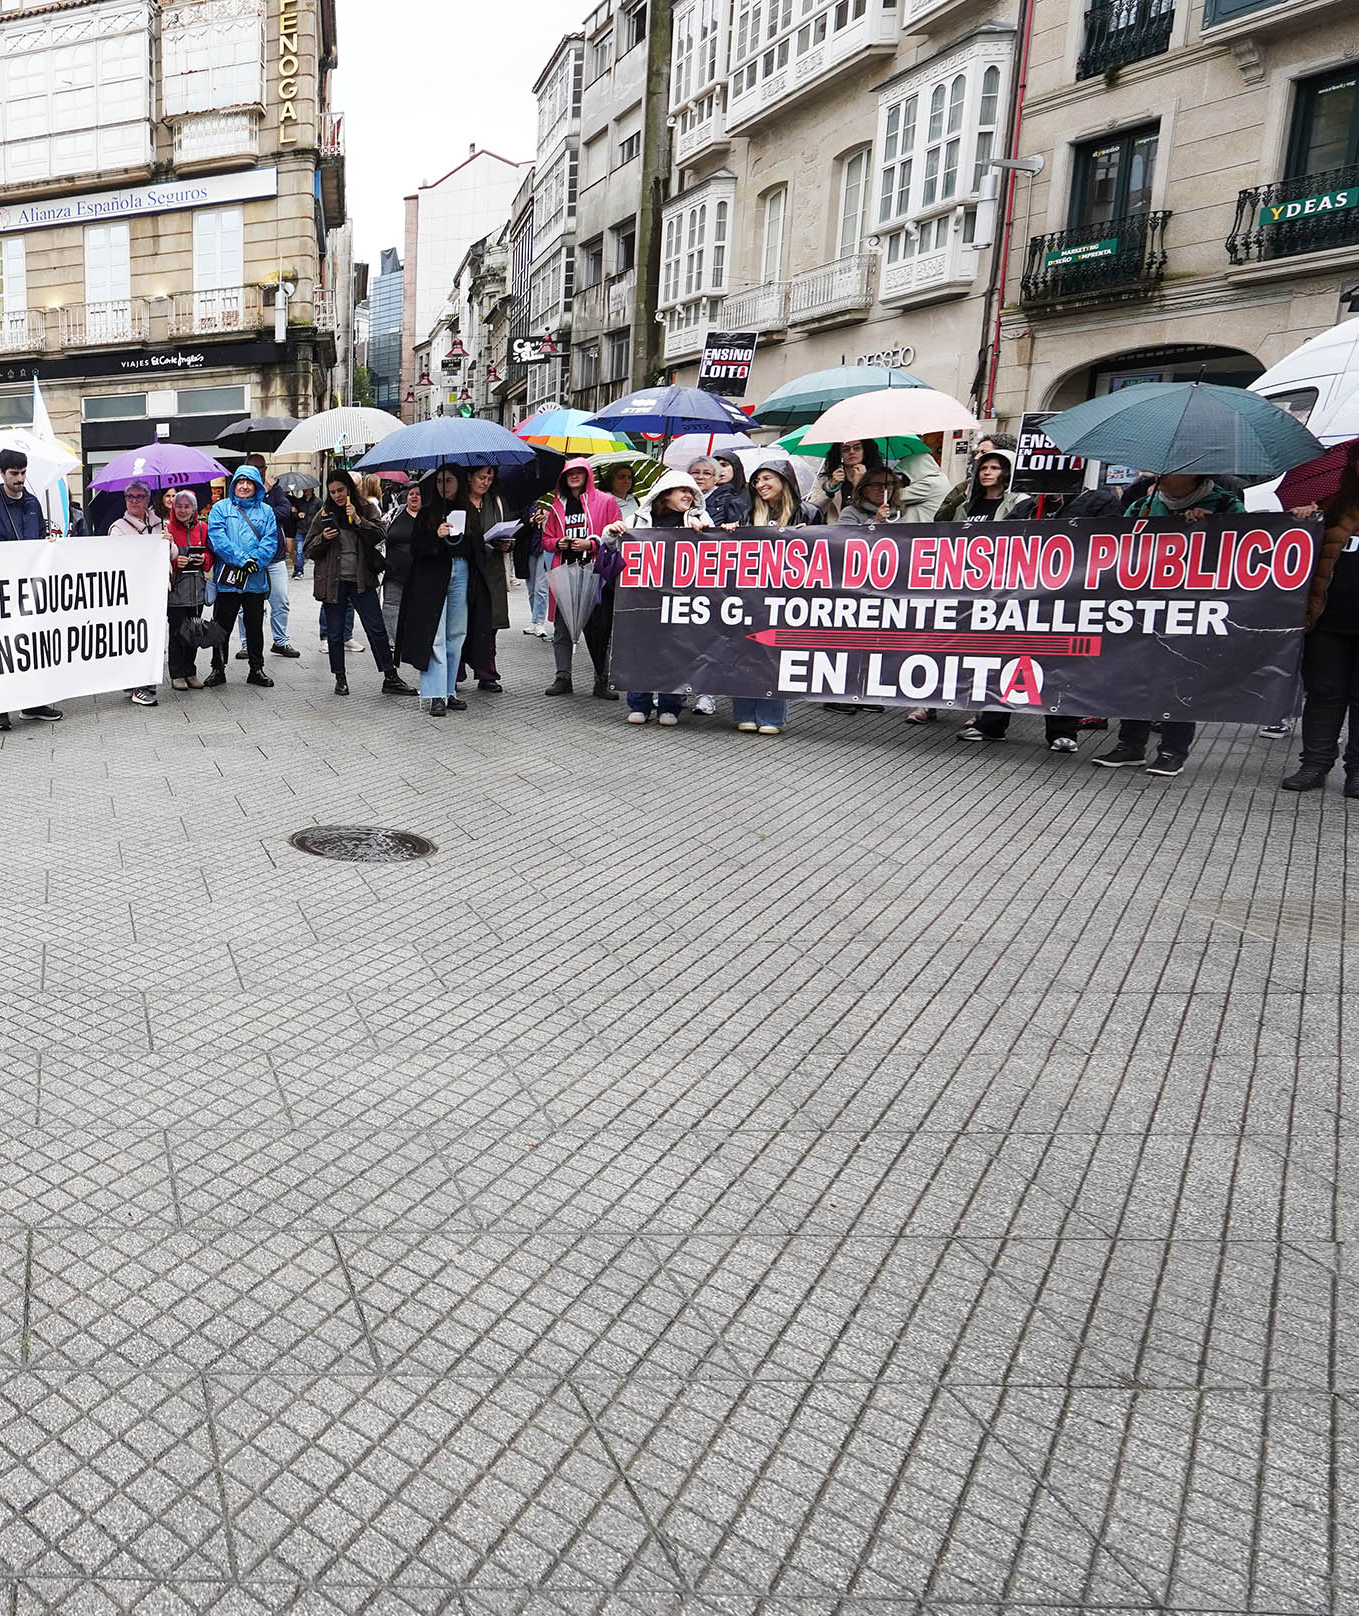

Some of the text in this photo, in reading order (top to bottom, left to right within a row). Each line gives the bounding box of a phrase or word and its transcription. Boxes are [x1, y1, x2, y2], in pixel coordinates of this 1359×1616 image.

[19, 187, 208, 223] Alianza Española Seguros
[1270, 192, 1348, 221] YDEAS
[120, 359, 149, 369] VIAJES
[703, 348, 753, 361] ENSINO
[700, 365, 749, 379] LOITA
[1018, 448, 1033, 456] EN
[1019, 433, 1056, 449] ENS
[1016, 454, 1085, 471] LOITA
[619, 520, 1314, 592] EN DEFENSA DO ENSINO PÚBLICO
[19, 569, 129, 617] EDUCATIVA
[660, 596, 1230, 636] IES G. TORRENTE BALLESTER
[67, 618, 149, 664] PÚBLICO
[777, 650, 1044, 706] EN LOITA
